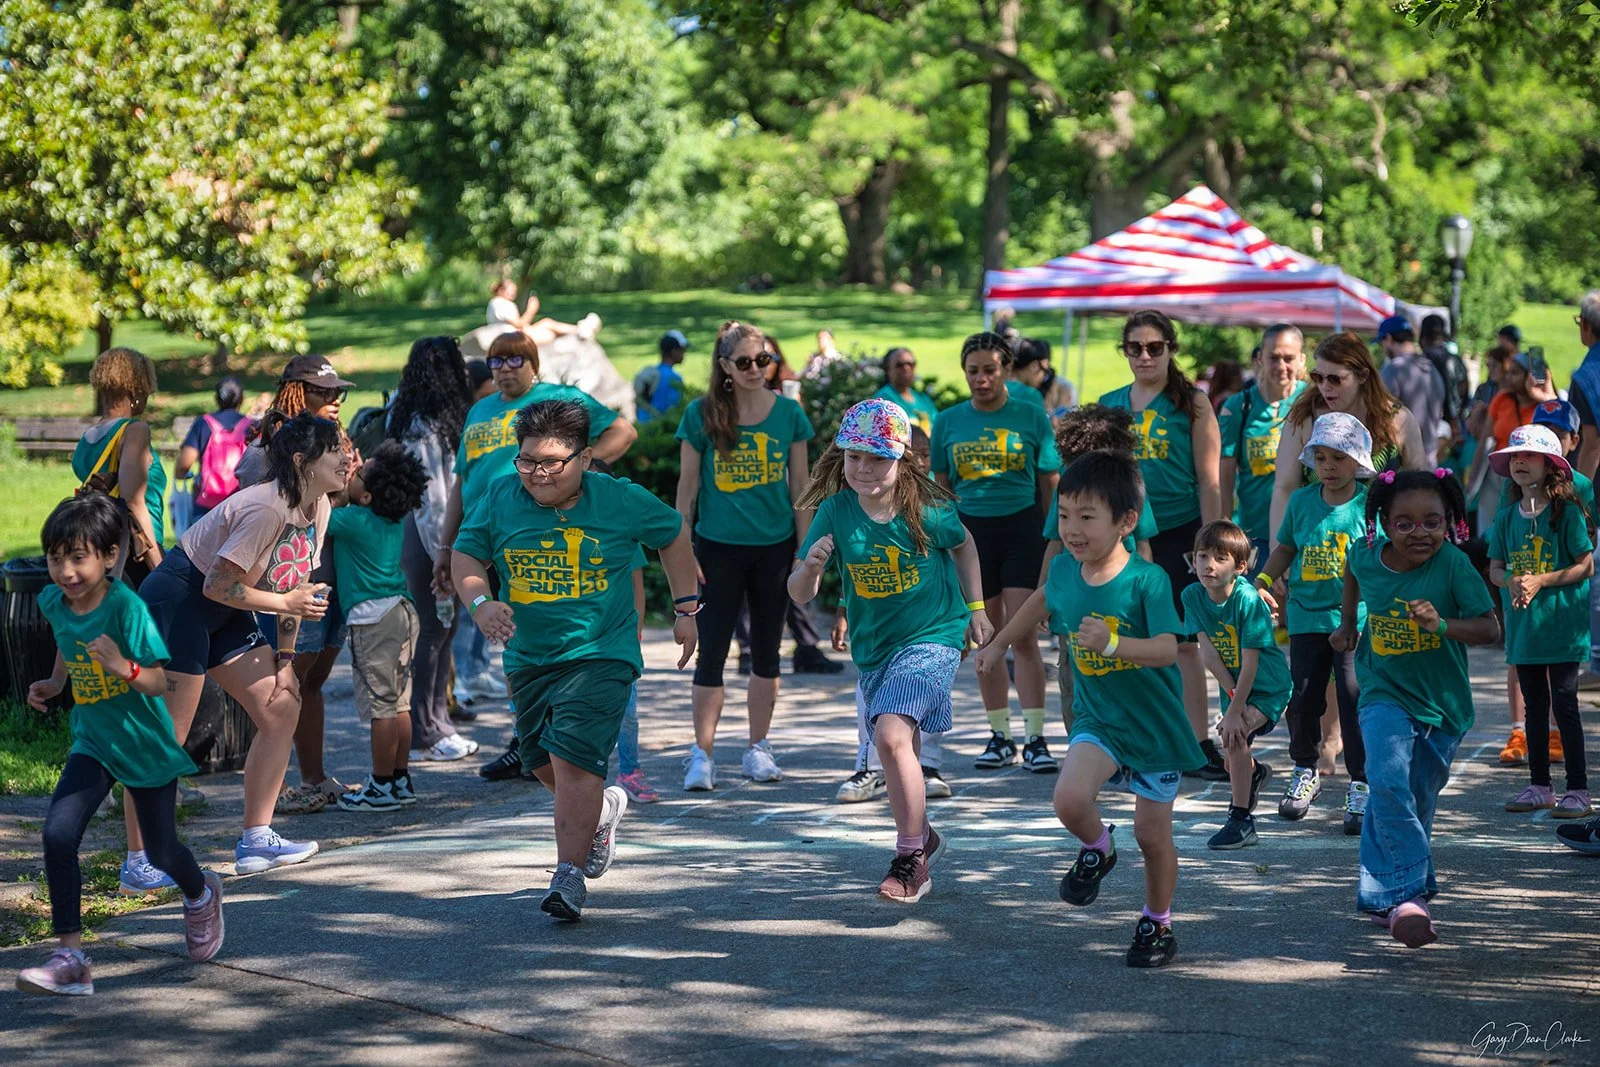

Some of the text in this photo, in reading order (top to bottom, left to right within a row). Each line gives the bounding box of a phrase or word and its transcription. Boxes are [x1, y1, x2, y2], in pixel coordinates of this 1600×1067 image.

[957, 444, 1003, 453] SOCIAL
[715, 454, 763, 463] SCIAL
[957, 453, 1003, 464] JUSTICE
[717, 464, 765, 474] JUSTICE
[732, 474, 764, 482] RUN
[1304, 550, 1341, 559] SOCIAL
[509, 554, 573, 568] SOCIAL
[1303, 558, 1342, 569] JUSTICE
[580, 568, 609, 581] PS
[850, 566, 896, 575] SOCIAL
[902, 567, 919, 580] PS
[853, 573, 898, 584] JUSTICE
[903, 576, 920, 591] 20
[529, 581, 575, 596] RUN
[580, 579, 609, 595] 20
[867, 584, 898, 593] RUN
[1371, 618, 1415, 633] SOCIAL
[1371, 626, 1416, 642] JUSTICE
[1384, 640, 1417, 651] RUN
[1420, 641, 1441, 651] 20
[1085, 659, 1117, 671] RUN
[68, 667, 99, 677] OCIAL
